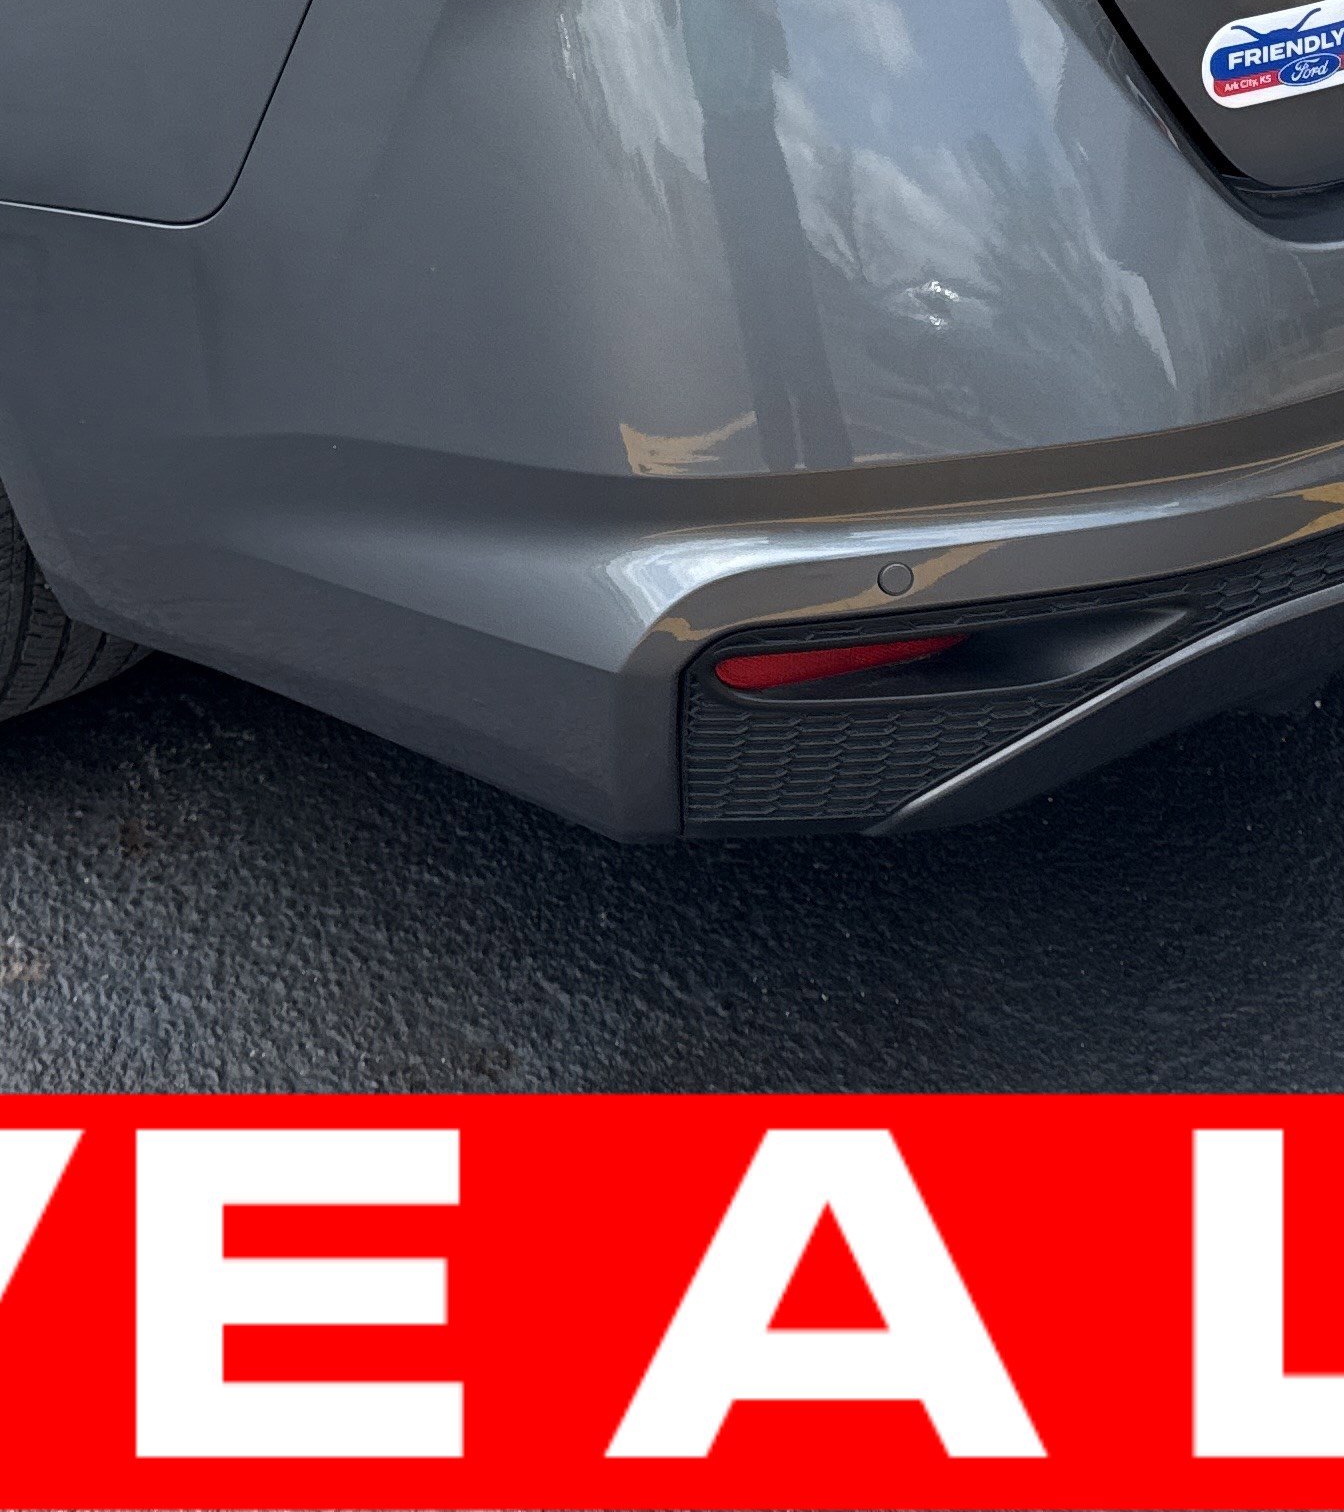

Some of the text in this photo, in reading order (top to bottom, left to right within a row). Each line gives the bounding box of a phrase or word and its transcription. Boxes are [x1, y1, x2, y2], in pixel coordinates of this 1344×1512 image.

[1290, 57, 1330, 82] Ford
[1224, 79, 1239, 93] Ark
[1259, 74, 1272, 86] KS
